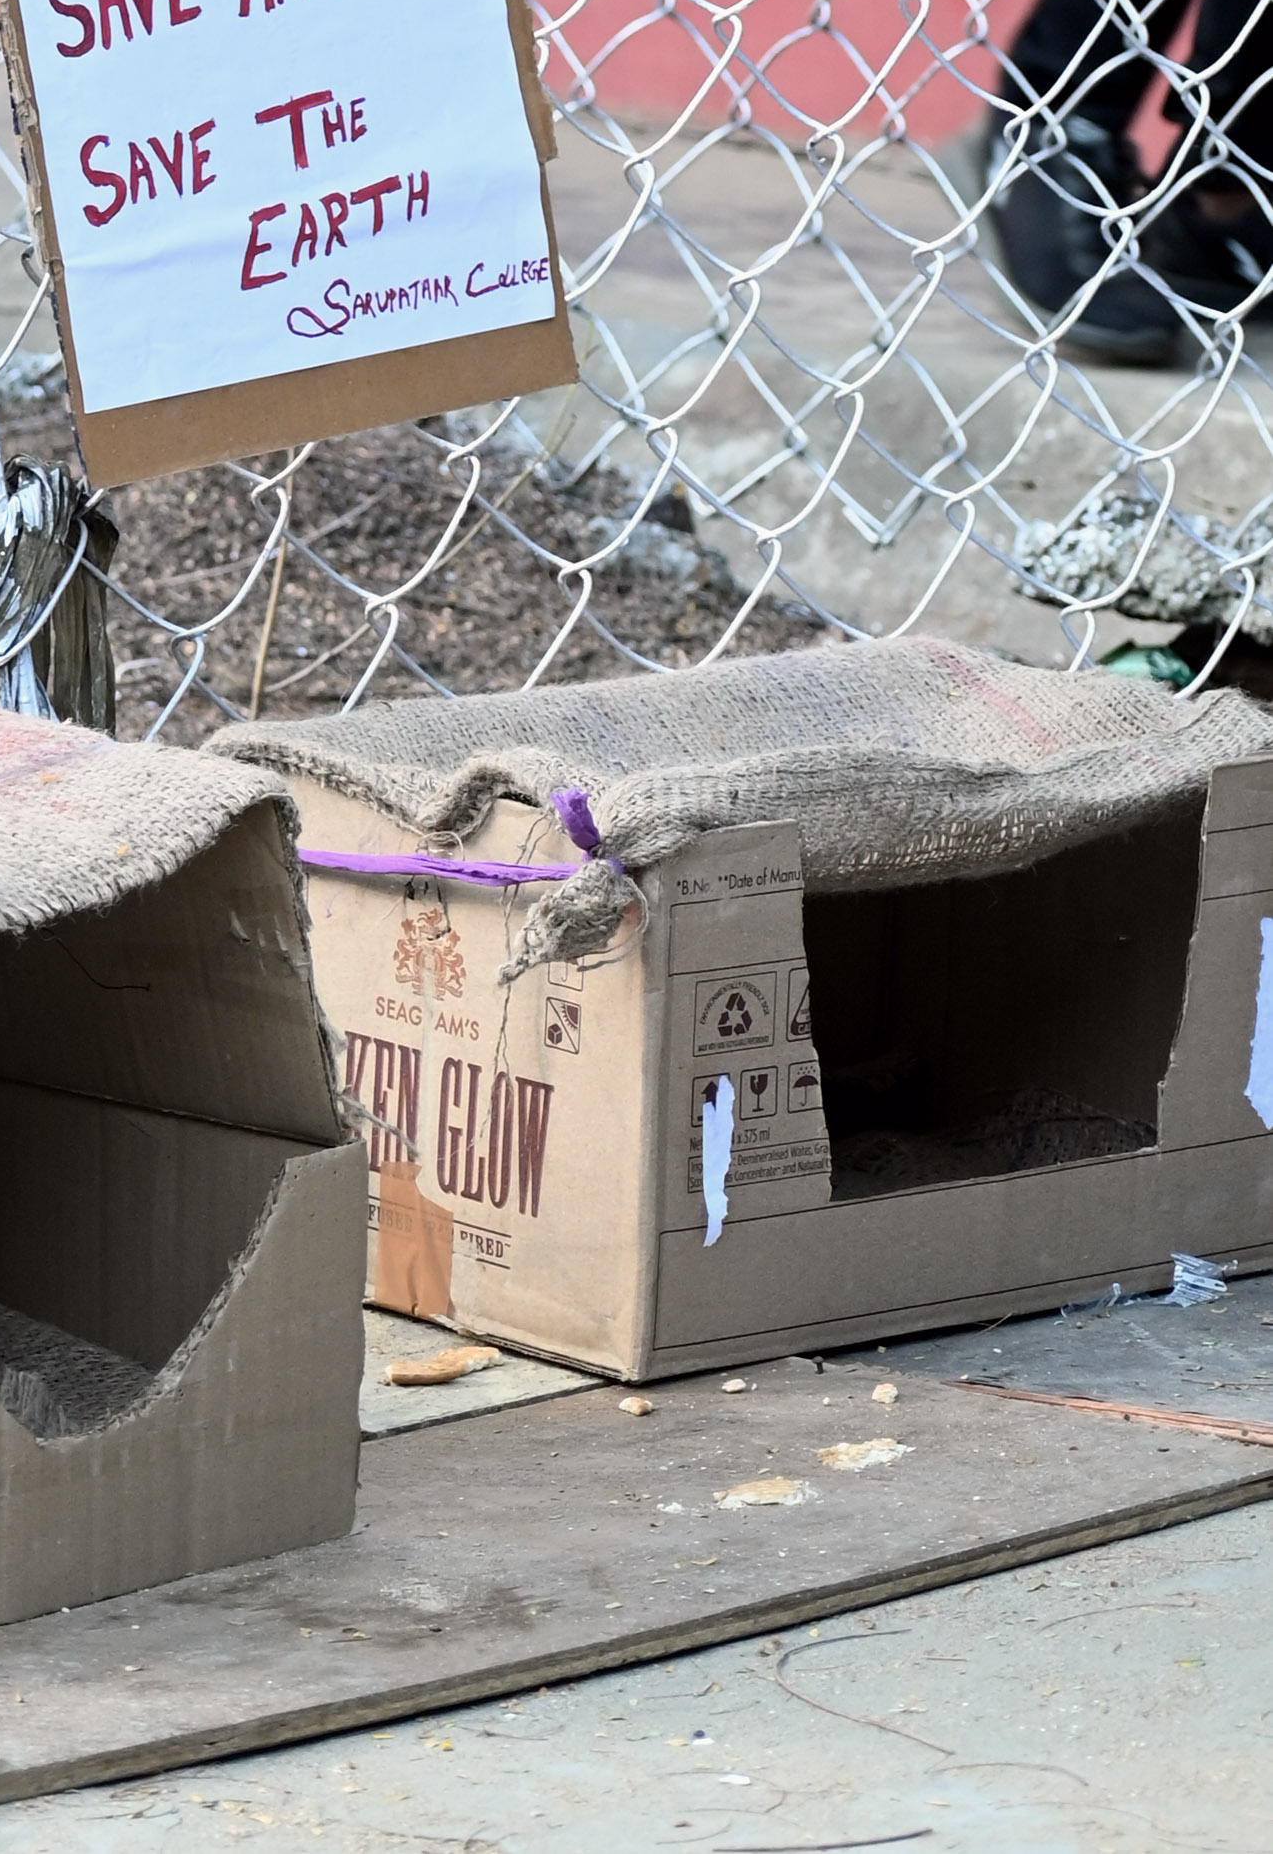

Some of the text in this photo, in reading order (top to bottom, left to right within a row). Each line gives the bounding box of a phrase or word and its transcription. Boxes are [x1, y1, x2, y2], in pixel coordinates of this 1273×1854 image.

[79, 89, 367, 227] SAVE THE
[240, 170, 430, 291] EARTH
[756, 867, 767, 886] of
[376, 996, 480, 1041] SEAGAM'S
[437, 1057, 555, 1218] GLOW
